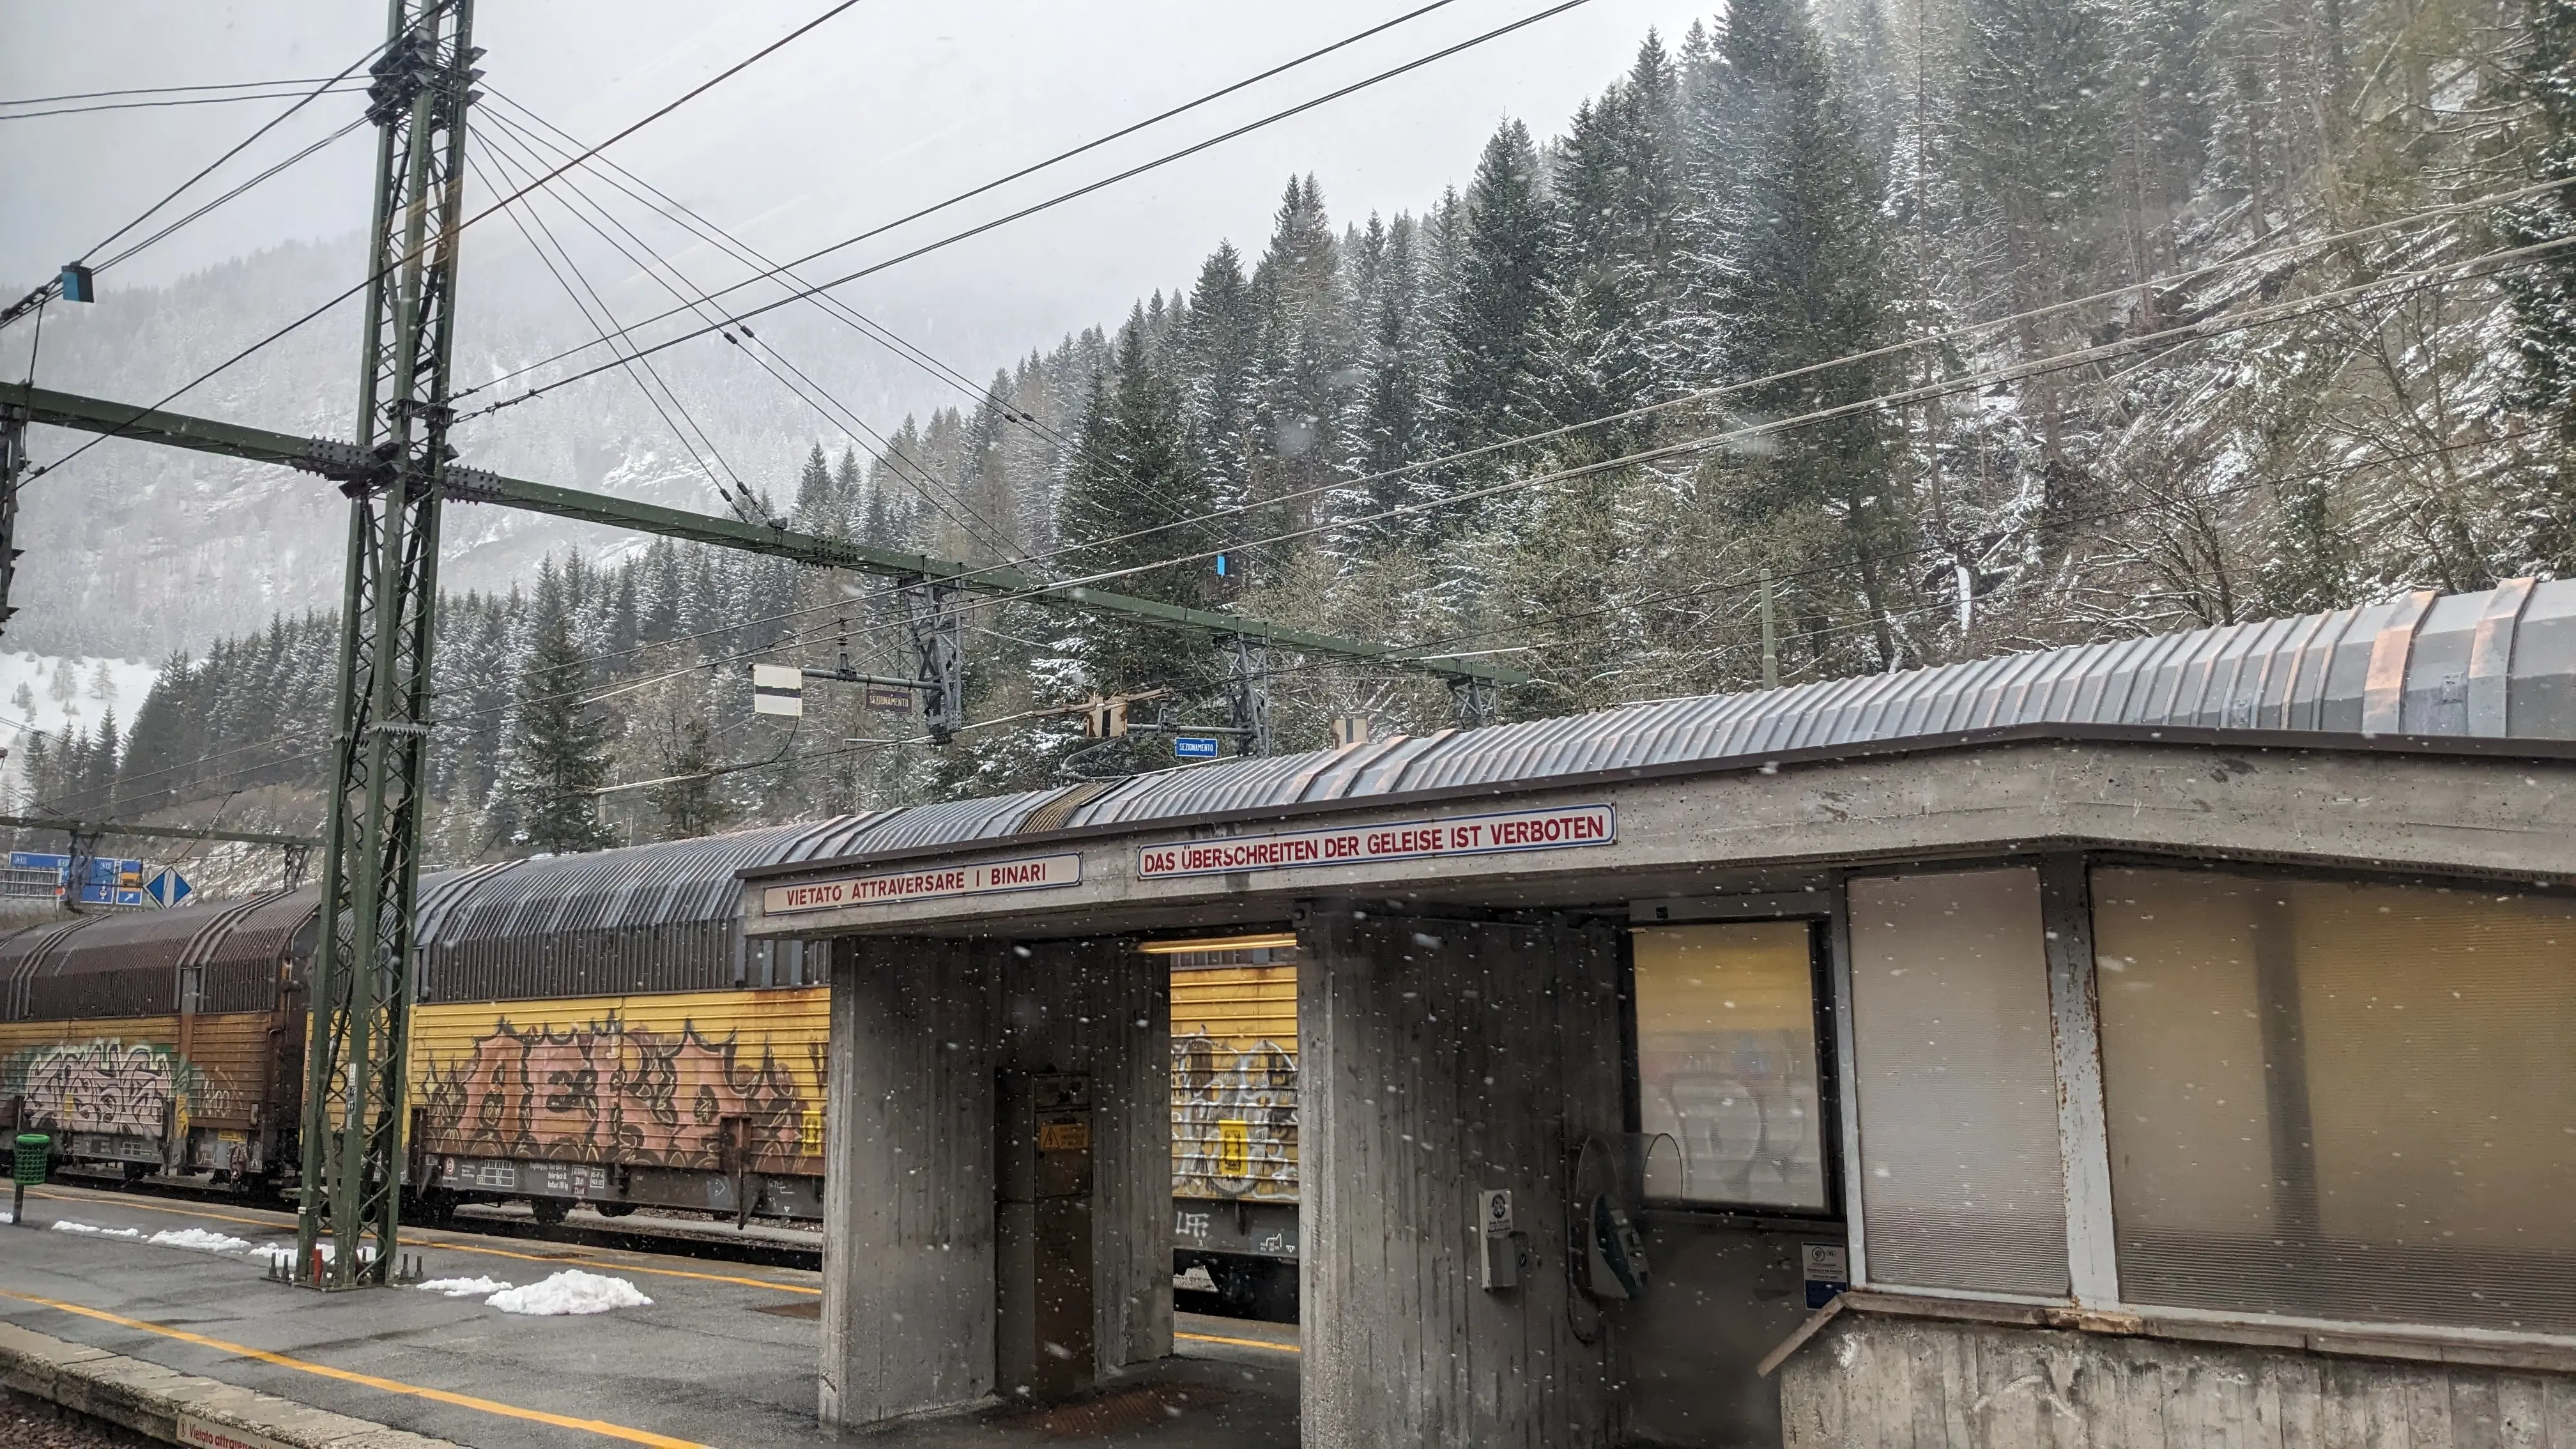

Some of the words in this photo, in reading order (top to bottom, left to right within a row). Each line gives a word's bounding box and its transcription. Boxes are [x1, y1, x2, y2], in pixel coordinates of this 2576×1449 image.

[870, 695, 908, 707] SEZIONAMENTO
[1179, 743, 1213, 752] SEZIONAMENTO
[1145, 852, 1176, 873] DAS
[1182, 839, 1319, 870] ÜBERSCHREITEN
[1325, 836, 1360, 858] DER
[1367, 828, 1444, 854] GELEISE
[1451, 825, 1482, 848] IST
[1490, 815, 1604, 846] VERBOTEN
[787, 885, 843, 906] VIETATO
[852, 872, 965, 900] ATTRAVERSARE
[976, 870, 981, 887] I
[992, 862, 1047, 885] BINARI
[189, 1423, 213, 1445] Vietato
